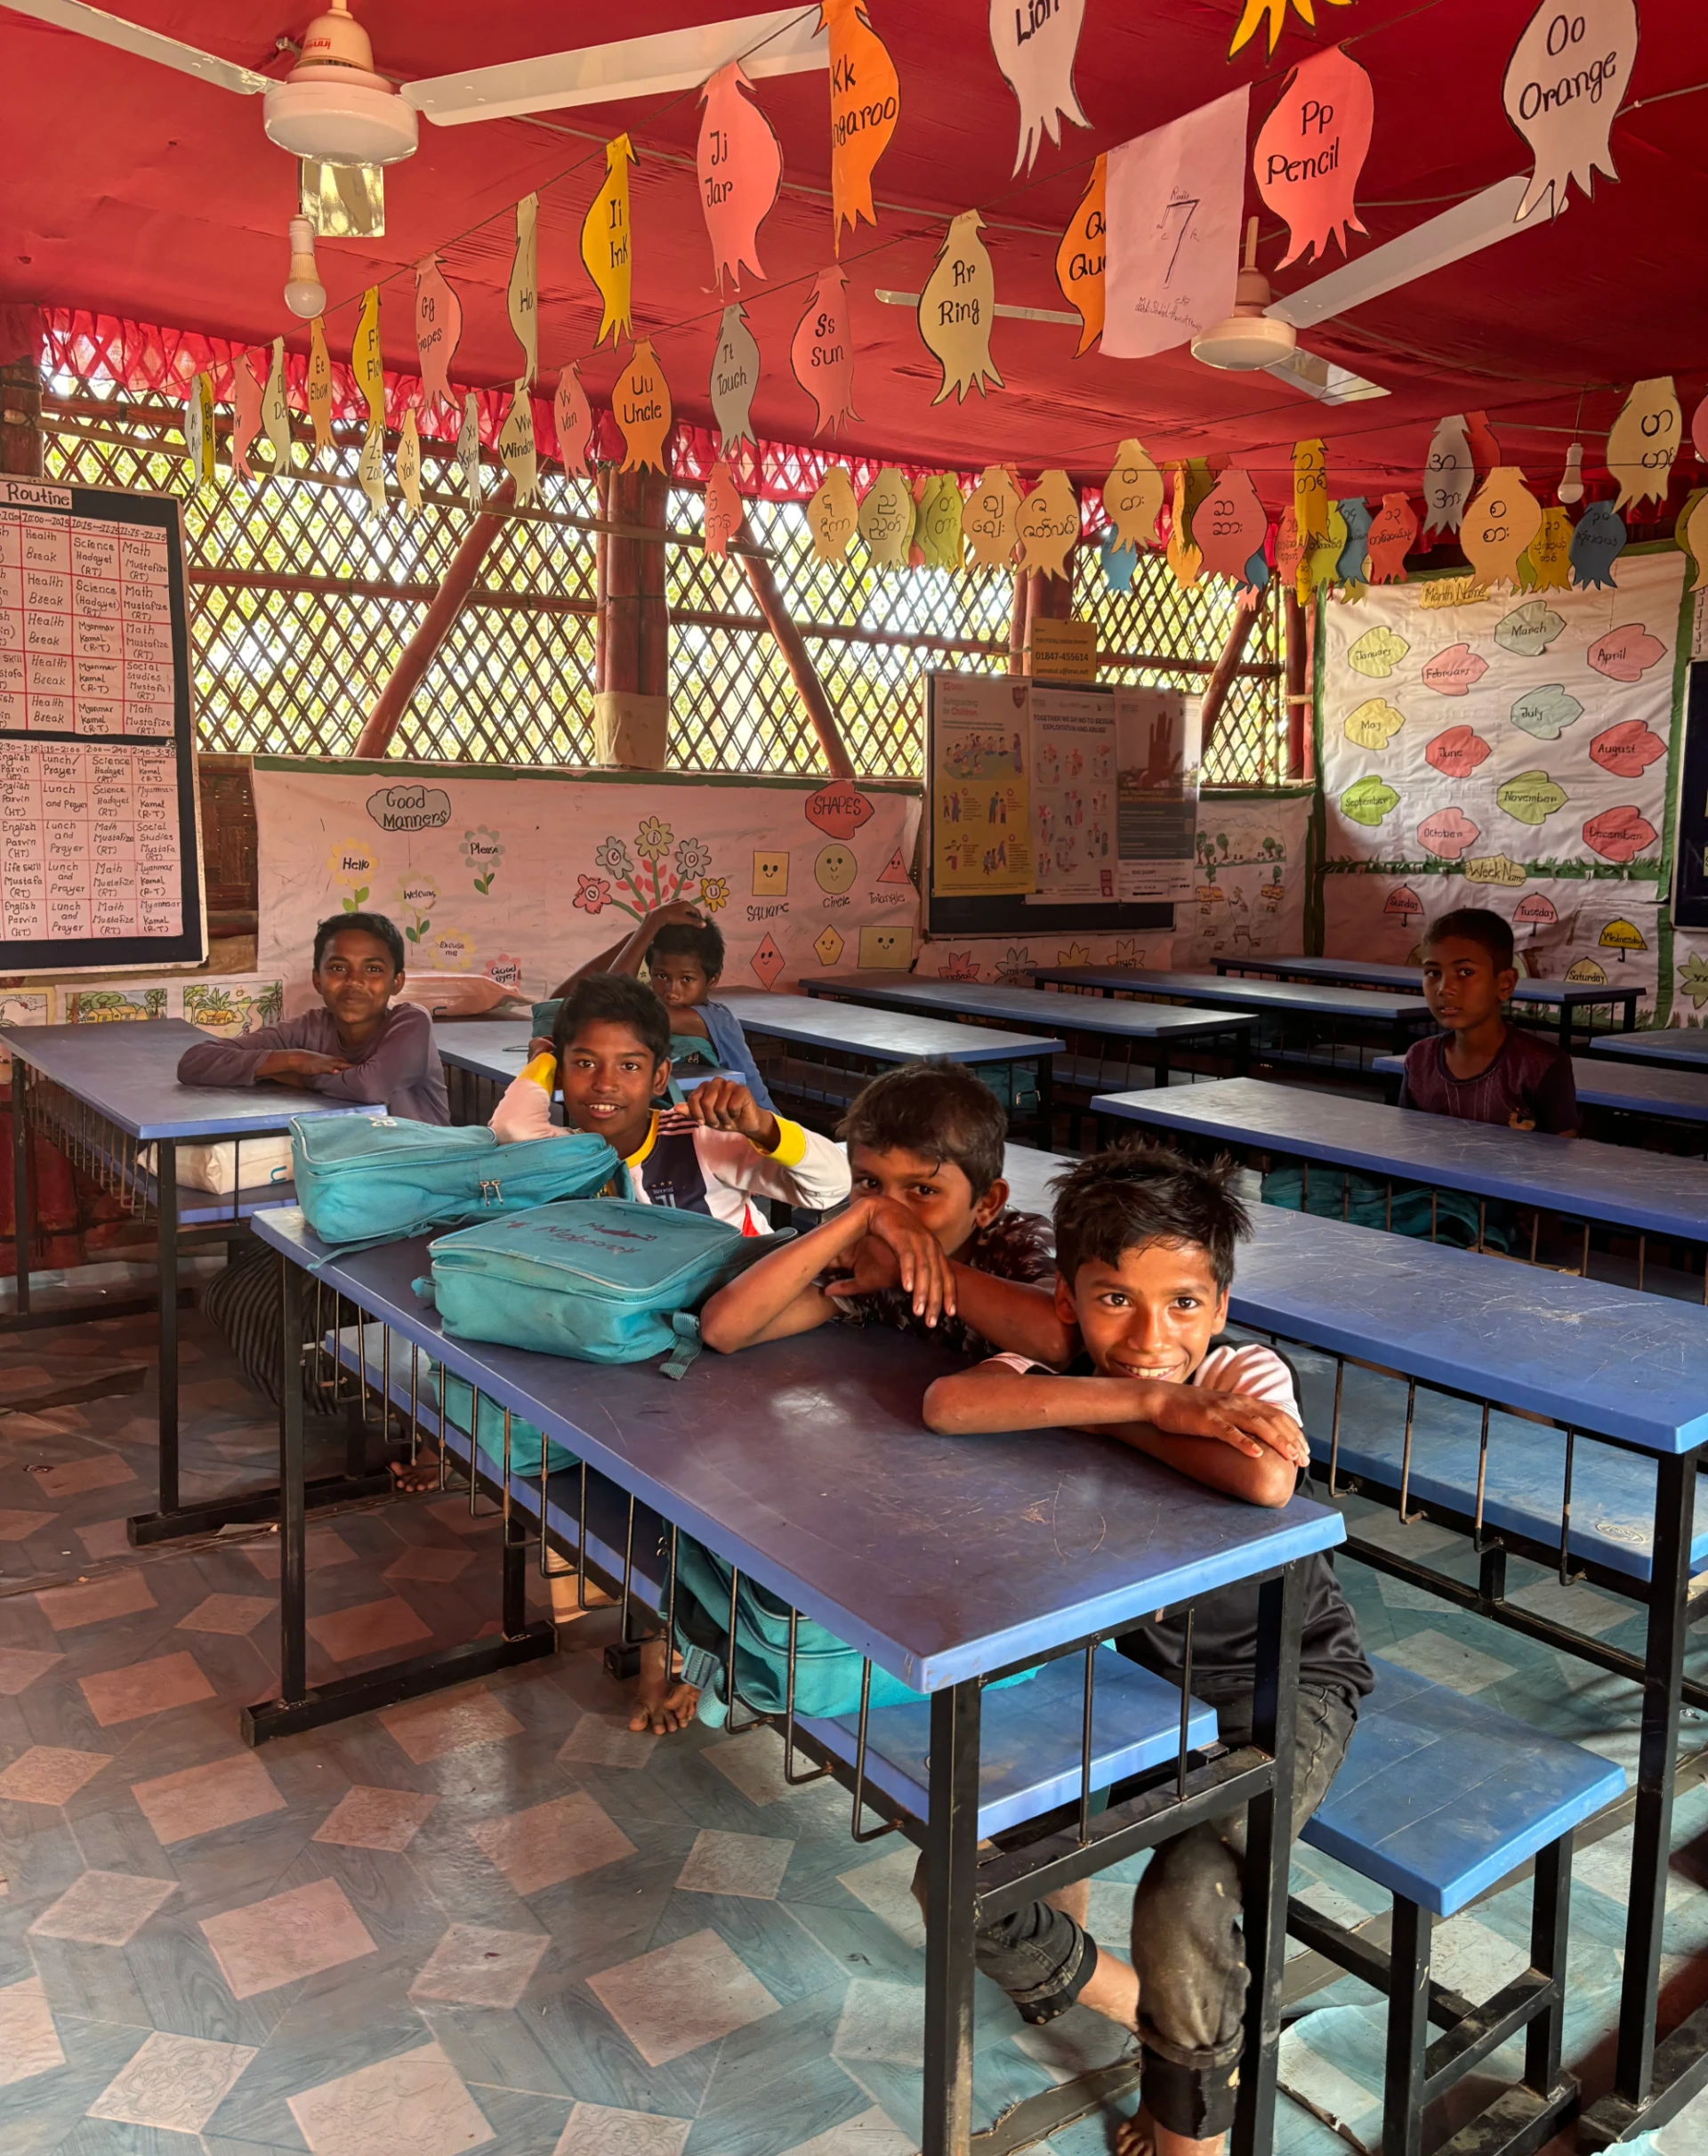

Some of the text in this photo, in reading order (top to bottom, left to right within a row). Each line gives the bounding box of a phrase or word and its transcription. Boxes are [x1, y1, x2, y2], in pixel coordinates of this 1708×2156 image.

[1016, 0, 1059, 47] Lion
[1545, 14, 1586, 56] Oo
[1518, 51, 1617, 120] Orange
[832, 96, 897, 149] ngaroo
[1301, 101, 1333, 136] Pp
[1265, 136, 1340, 185] Pencil
[704, 176, 733, 208] Jar
[952, 259, 976, 287] Rr
[938, 298, 980, 327] Ring
[810, 343, 844, 367] Sun
[632, 375, 654, 396] Uu
[717, 367, 747, 396] Touch
[623, 400, 663, 424] Uncle
[560, 411, 578, 432] Van
[6, 482, 70, 505] Routine
[26, 529, 57, 541] Health
[74, 537, 115, 551] Science
[122, 541, 151, 557] Math
[26, 546, 57, 562] Break
[81, 565, 102, 577] (RT)
[28, 572, 63, 587] Health
[76, 579, 117, 594] Science
[28, 592, 63, 606] Break
[125, 585, 153, 598] Math
[1424, 587, 1453, 602] Month
[1511, 622, 1547, 637] March
[1035, 651, 1089, 661] 01847-455614
[1356, 649, 1392, 661] January
[1598, 647, 1626, 664] April
[1426, 668, 1470, 679] February
[1520, 707, 1543, 721] July
[1361, 721, 1382, 731] May
[1438, 747, 1462, 757] June
[1598, 744, 1636, 757] August
[386, 788, 425, 810] Good
[1504, 791, 1557, 803] November
[812, 795, 862, 816] SHAPES
[2, 821, 36, 836] English
[94, 822, 117, 831] Math
[136, 822, 166, 832] Social
[1424, 828, 1462, 838] October
[1589, 827, 1642, 841] December
[140, 833, 173, 842] Studies
[470, 843, 499, 855] Please
[342, 857, 370, 871] Hello
[1470, 862, 1526, 883] Week Name
[52, 900, 81, 911] Lunch
[823, 895, 850, 908] Circle
[868, 892, 906, 905] Triangle
[1390, 896, 1418, 911] Sunday
[4, 901, 36, 915] English
[61, 911, 78, 920] and
[1603, 932, 1644, 948] Wednesday
[491, 964, 517, 976] Good
[1569, 970, 1605, 985] Saturday
